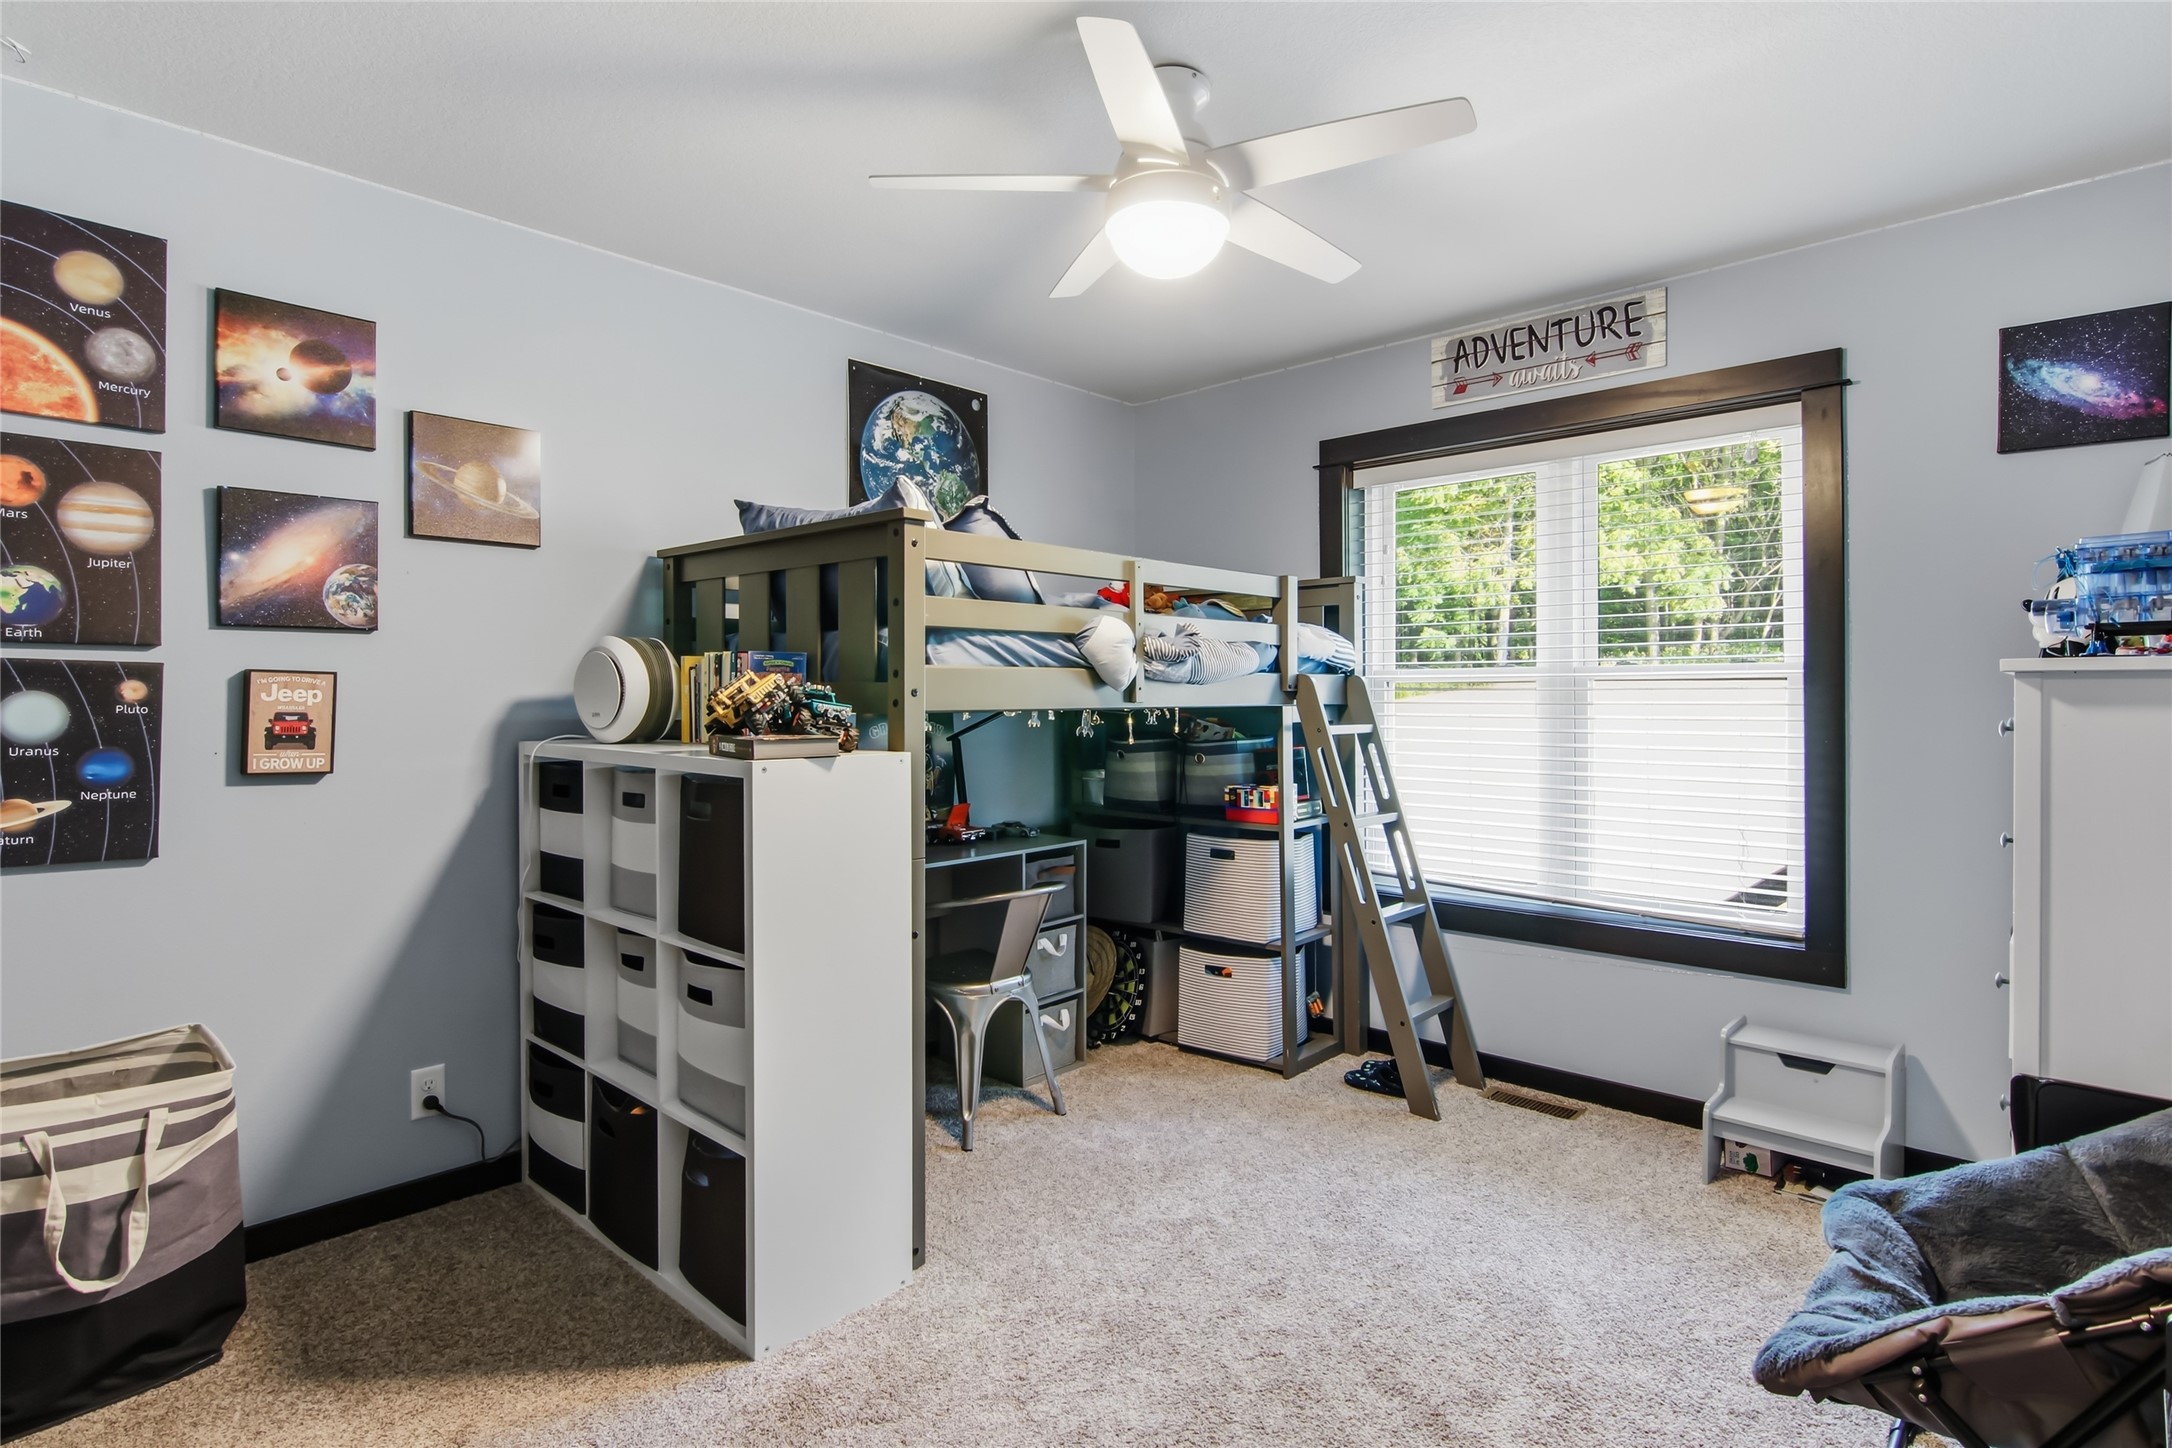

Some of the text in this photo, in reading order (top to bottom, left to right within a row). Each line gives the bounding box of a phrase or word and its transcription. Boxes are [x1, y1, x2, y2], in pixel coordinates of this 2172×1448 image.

[69, 302, 112, 319] Venus
[1453, 300, 1644, 374] ADVENTURE
[1508, 352, 1583, 388] awaits
[98, 380, 151, 399] Mercury
[87, 557, 132, 569] Jupiter
[5, 627, 43, 638] Earth
[260, 683, 323, 706] Jeep
[115, 704, 149, 714] Pluto
[8, 746, 60, 757] Uranus
[252, 758, 325, 770] I GROW UP
[80, 790, 137, 801] Neptune
[1139, 983, 1144, 991] 6
